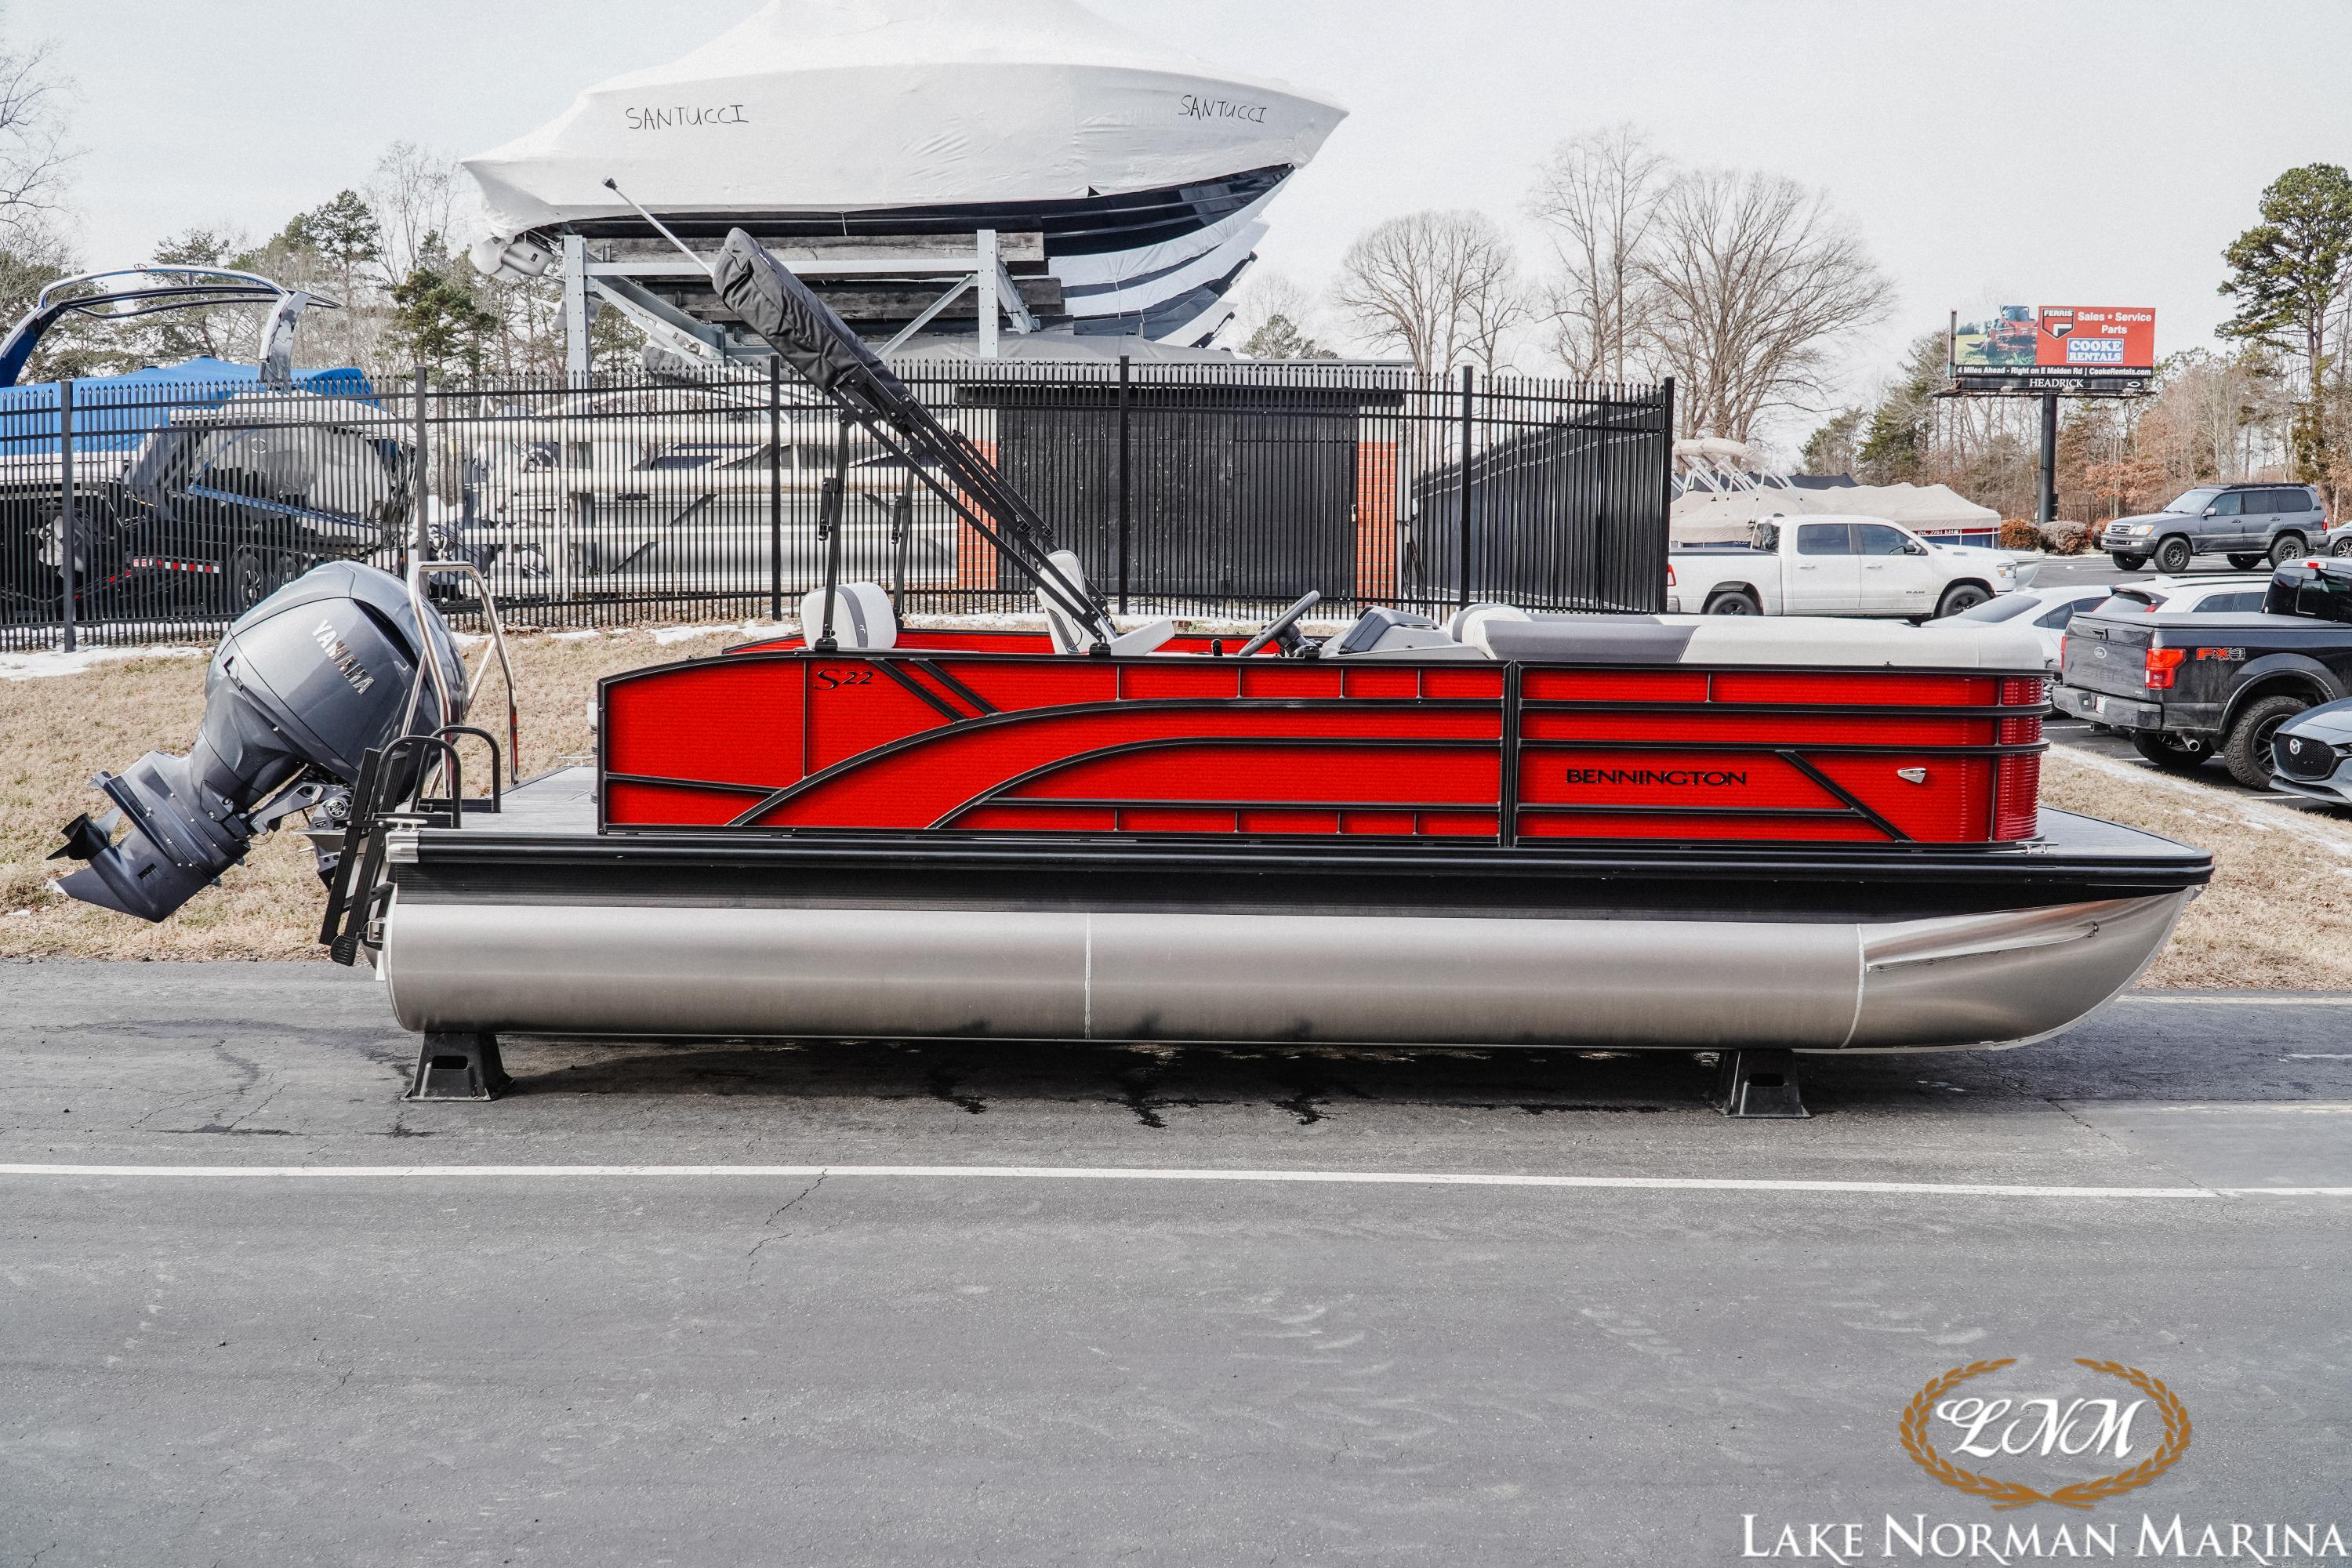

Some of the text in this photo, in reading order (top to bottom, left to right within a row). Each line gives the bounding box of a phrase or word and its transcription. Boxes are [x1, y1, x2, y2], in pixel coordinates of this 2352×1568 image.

[1178, 95, 1267, 124] SANTUCCI
[626, 104, 749, 130] SANTUCCI
[2078, 312, 2152, 322] Sales Service
[2101, 325, 2128, 334] Parts
[2070, 340, 2122, 351] COOKE
[2068, 352, 2122, 361] RENTALS
[2010, 367, 2029, 376] Right
[2029, 378, 2084, 387] HEADRICK
[312, 619, 374, 695] YAMAHA
[2196, 648, 2245, 660] FX4
[1566, 769, 1747, 786] BENNINGTON
